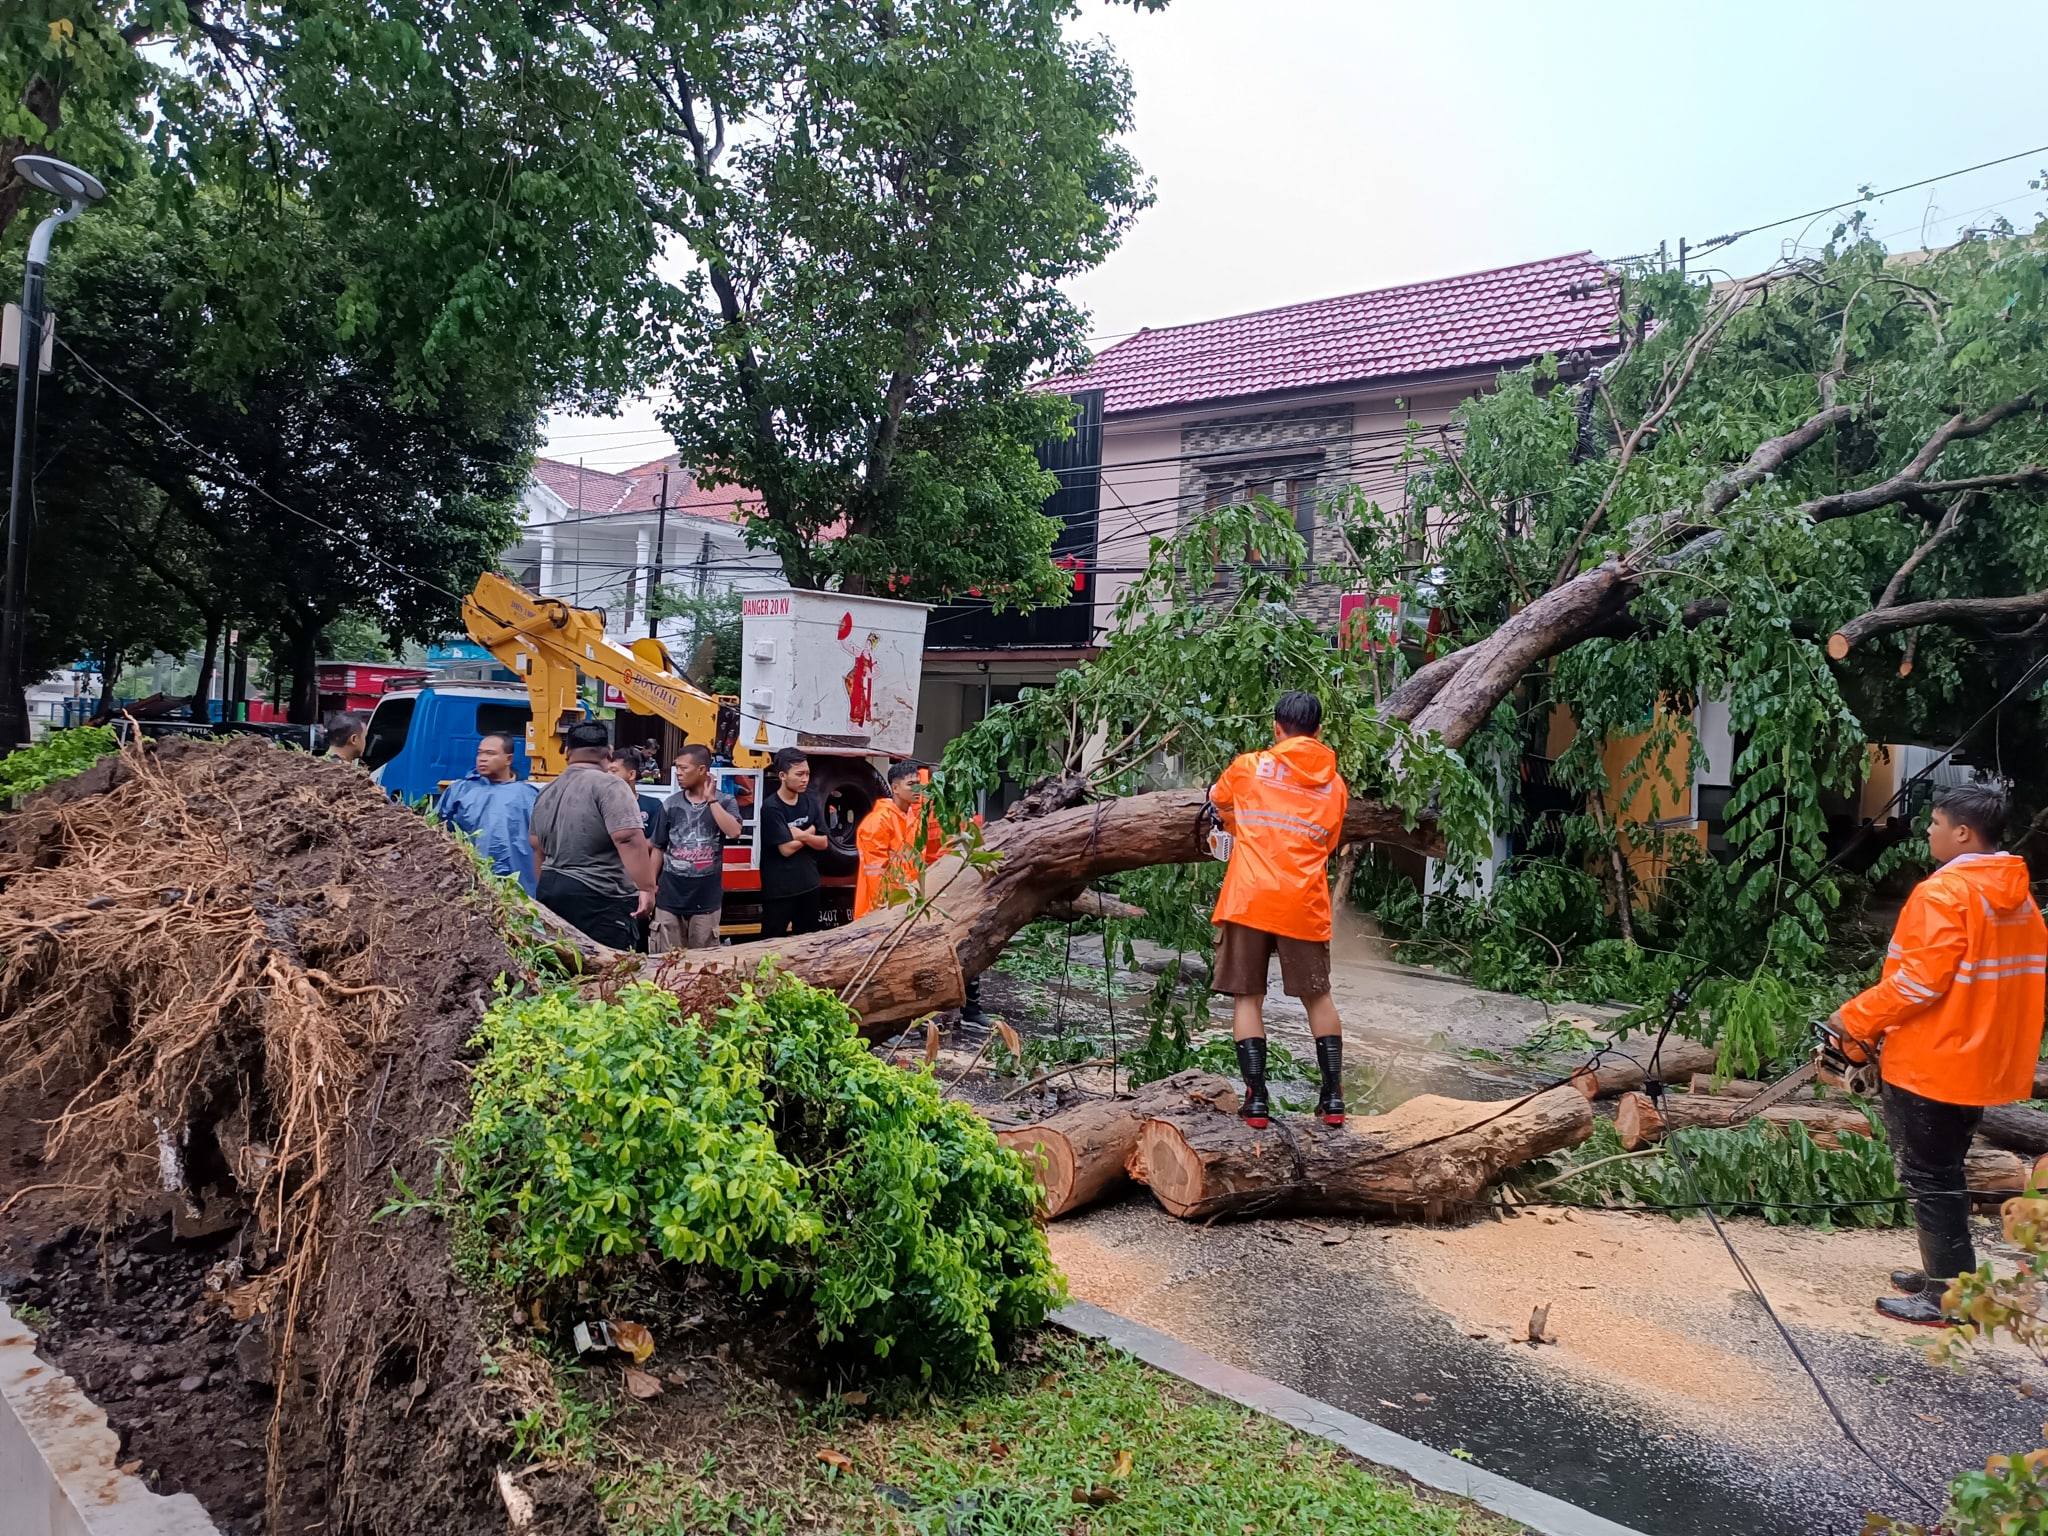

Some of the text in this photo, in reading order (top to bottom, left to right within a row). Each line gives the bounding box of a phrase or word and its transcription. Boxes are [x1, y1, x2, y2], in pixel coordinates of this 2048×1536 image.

[743, 597, 790, 616] DANGER 20 KV
[633, 673, 679, 707] DONGHAE
